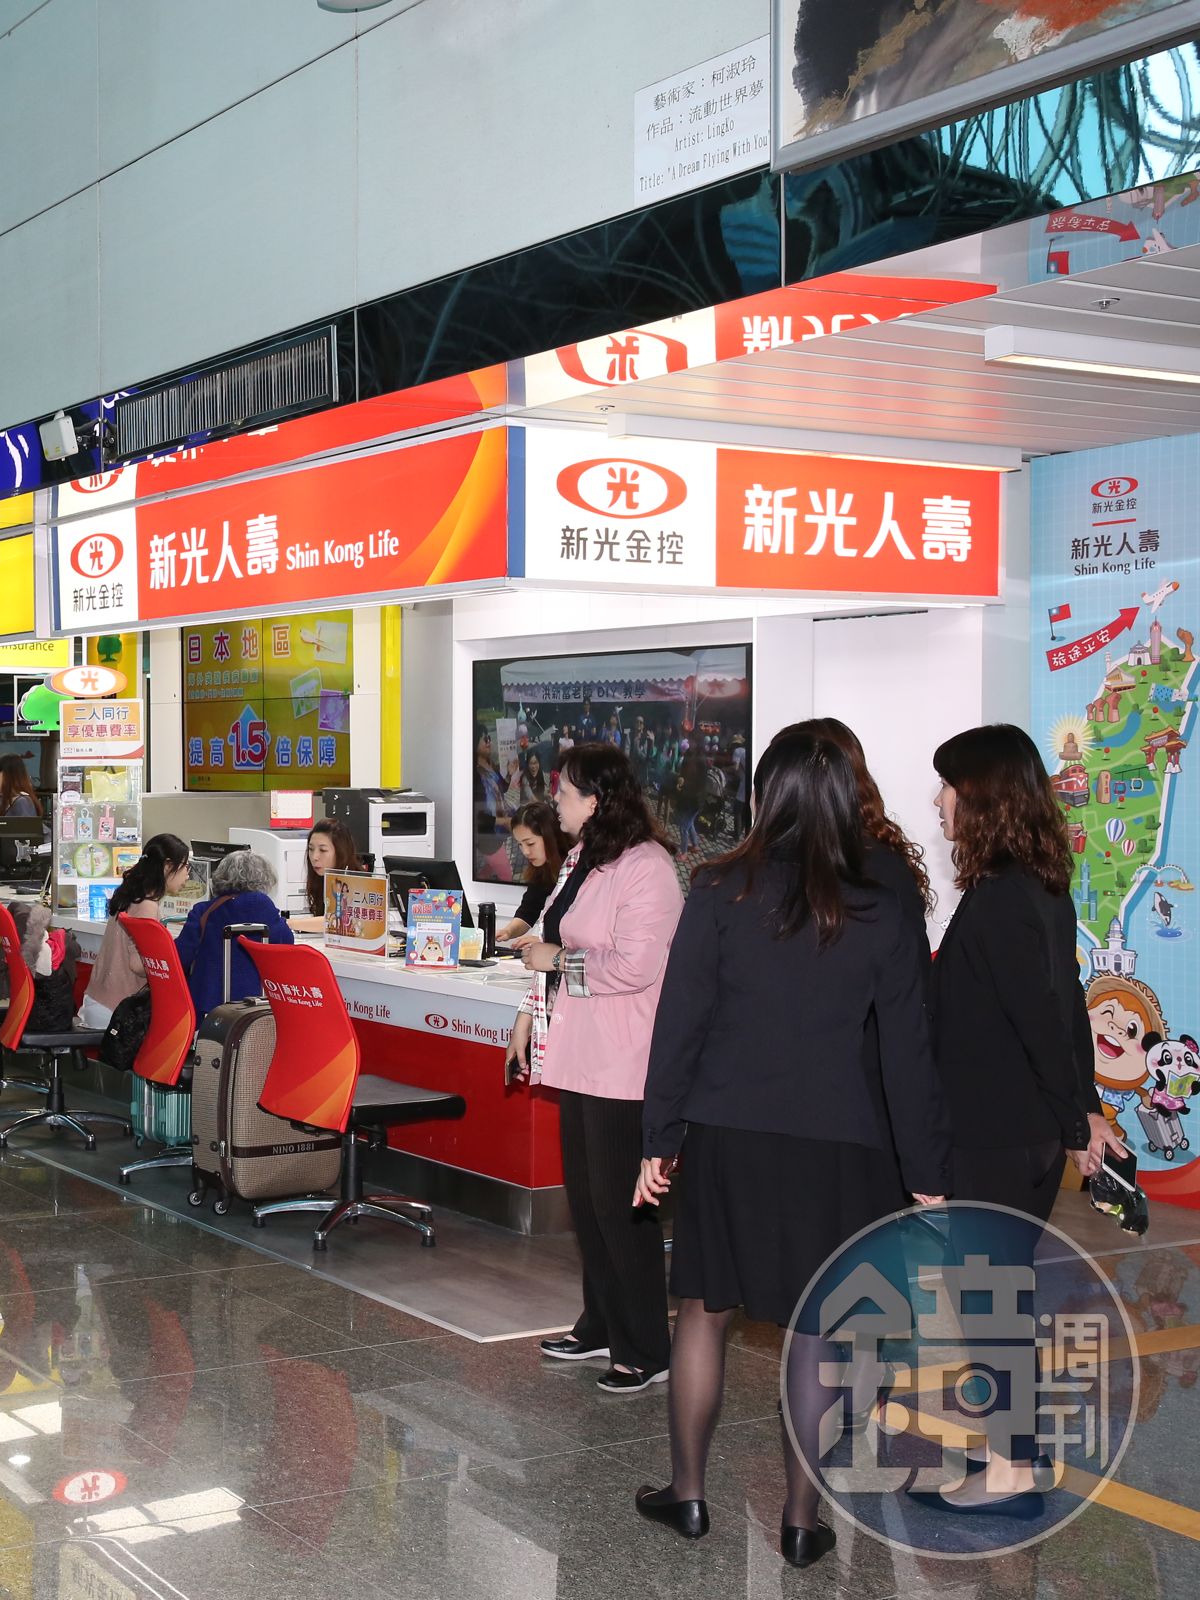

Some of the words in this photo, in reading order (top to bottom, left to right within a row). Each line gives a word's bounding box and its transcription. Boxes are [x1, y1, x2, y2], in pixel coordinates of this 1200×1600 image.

[654, 55, 756, 111] 藝術家：柯淑玲
[647, 79, 764, 141] 作品：流動世界夢
[674, 128, 704, 152] Artist:
[707, 117, 735, 140] LingKo
[640, 173, 664, 192] Title:
[678, 159, 700, 178] Dream
[703, 148, 730, 169] Flying
[732, 141, 751, 158] With
[1091, 498, 1138, 514] 新光金控
[743, 484, 972, 562] 新光人壽
[150, 514, 279, 590] 新光人壽
[286, 542, 319, 571] Shin
[324, 540, 364, 569] Kong
[369, 529, 399, 559] Life
[560, 525, 684, 565] 新光金控
[1071, 529, 1161, 560] 新光人壽
[1074, 562, 1099, 576] Shin
[1102, 560, 1131, 575] Kong
[1135, 558, 1156, 570] Life
[73, 583, 124, 612] 新光金控
[188, 624, 291, 664] 日本地區
[1052, 629, 1111, 667] 旅途平安
[597, 686, 617, 698] DIY
[75, 706, 129, 720] 二人同行
[68, 724, 137, 738] 享優惠費率
[354, 891, 384, 907] 二人同行
[282, 984, 323, 1000] 新光人壽
[353, 1000, 374, 1018] Kong
[375, 1003, 391, 1019] Life
[451, 1018, 472, 1035] Shin
[474, 1023, 498, 1044] Kong
[500, 1025, 513, 1042] Lif
[272, 1144, 295, 1155] NINO
[297, 1142, 315, 1153] 1881
